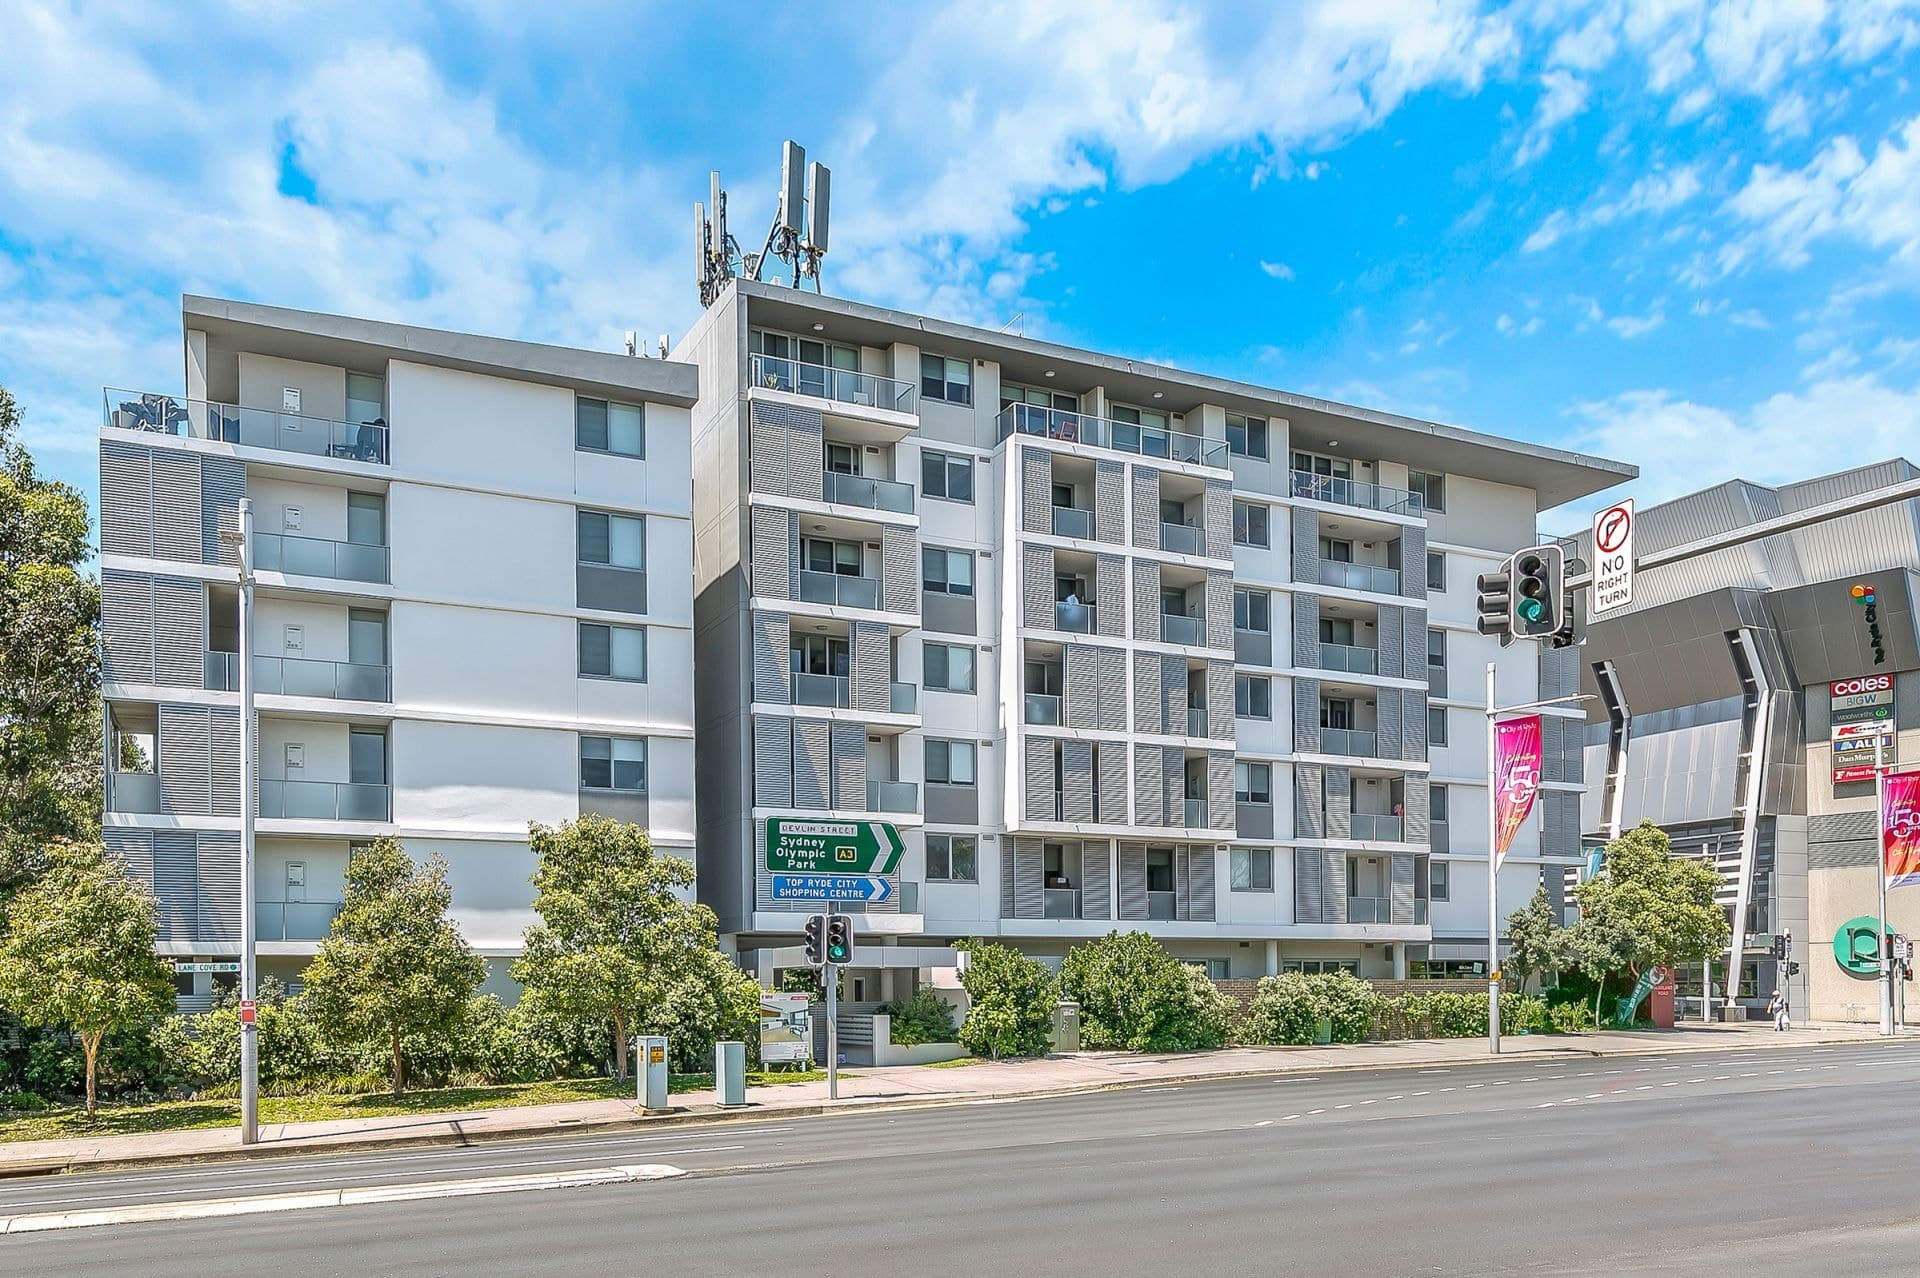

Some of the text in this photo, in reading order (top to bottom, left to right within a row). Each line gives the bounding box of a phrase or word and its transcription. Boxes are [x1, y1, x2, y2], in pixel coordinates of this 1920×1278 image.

[1602, 555, 1624, 576] NO
[1597, 572, 1628, 592] RIGHT
[1599, 588, 1628, 606] TURN
[1834, 676, 1890, 696] coles
[781, 823, 855, 834] DEVLIN STREET
[1887, 808, 1920, 838] 150
[780, 836, 826, 849] Sydney
[776, 847, 826, 860] Olympic
[839, 849, 854, 859] A3
[787, 859, 816, 869] Park
[785, 878, 858, 888] TOP RYDE CITY
[780, 888, 865, 898] SHOPPING CENTRE
